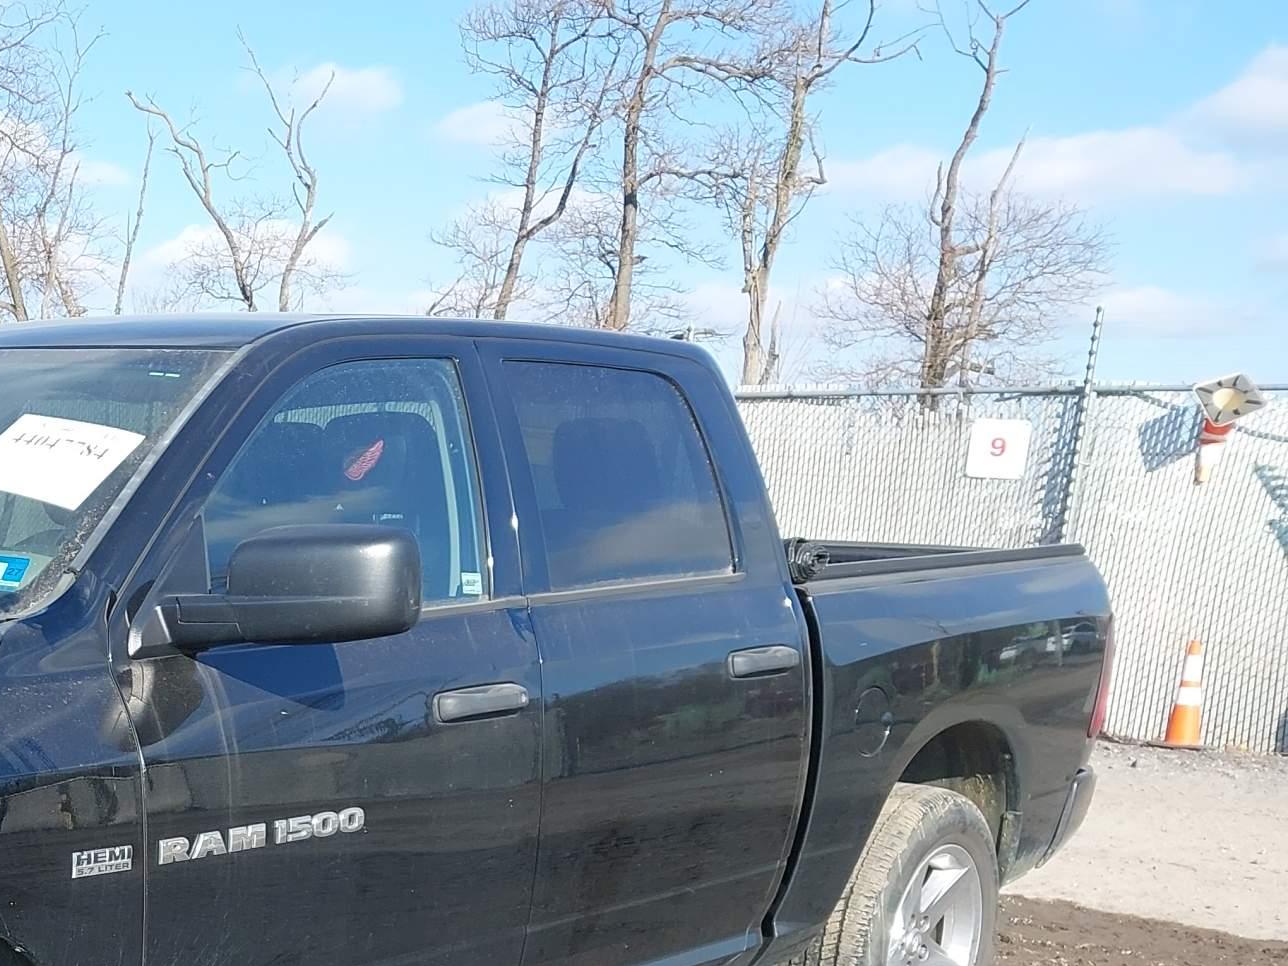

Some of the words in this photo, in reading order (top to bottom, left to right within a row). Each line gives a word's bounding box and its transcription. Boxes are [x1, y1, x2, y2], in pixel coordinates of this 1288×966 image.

[990, 437, 1007, 457] 9
[7, 567, 24, 576] 27
[159, 822, 266, 865] RAM
[274, 807, 365, 844] 1500
[76, 847, 132, 867] HEMI
[98, 862, 130, 873] LITER
